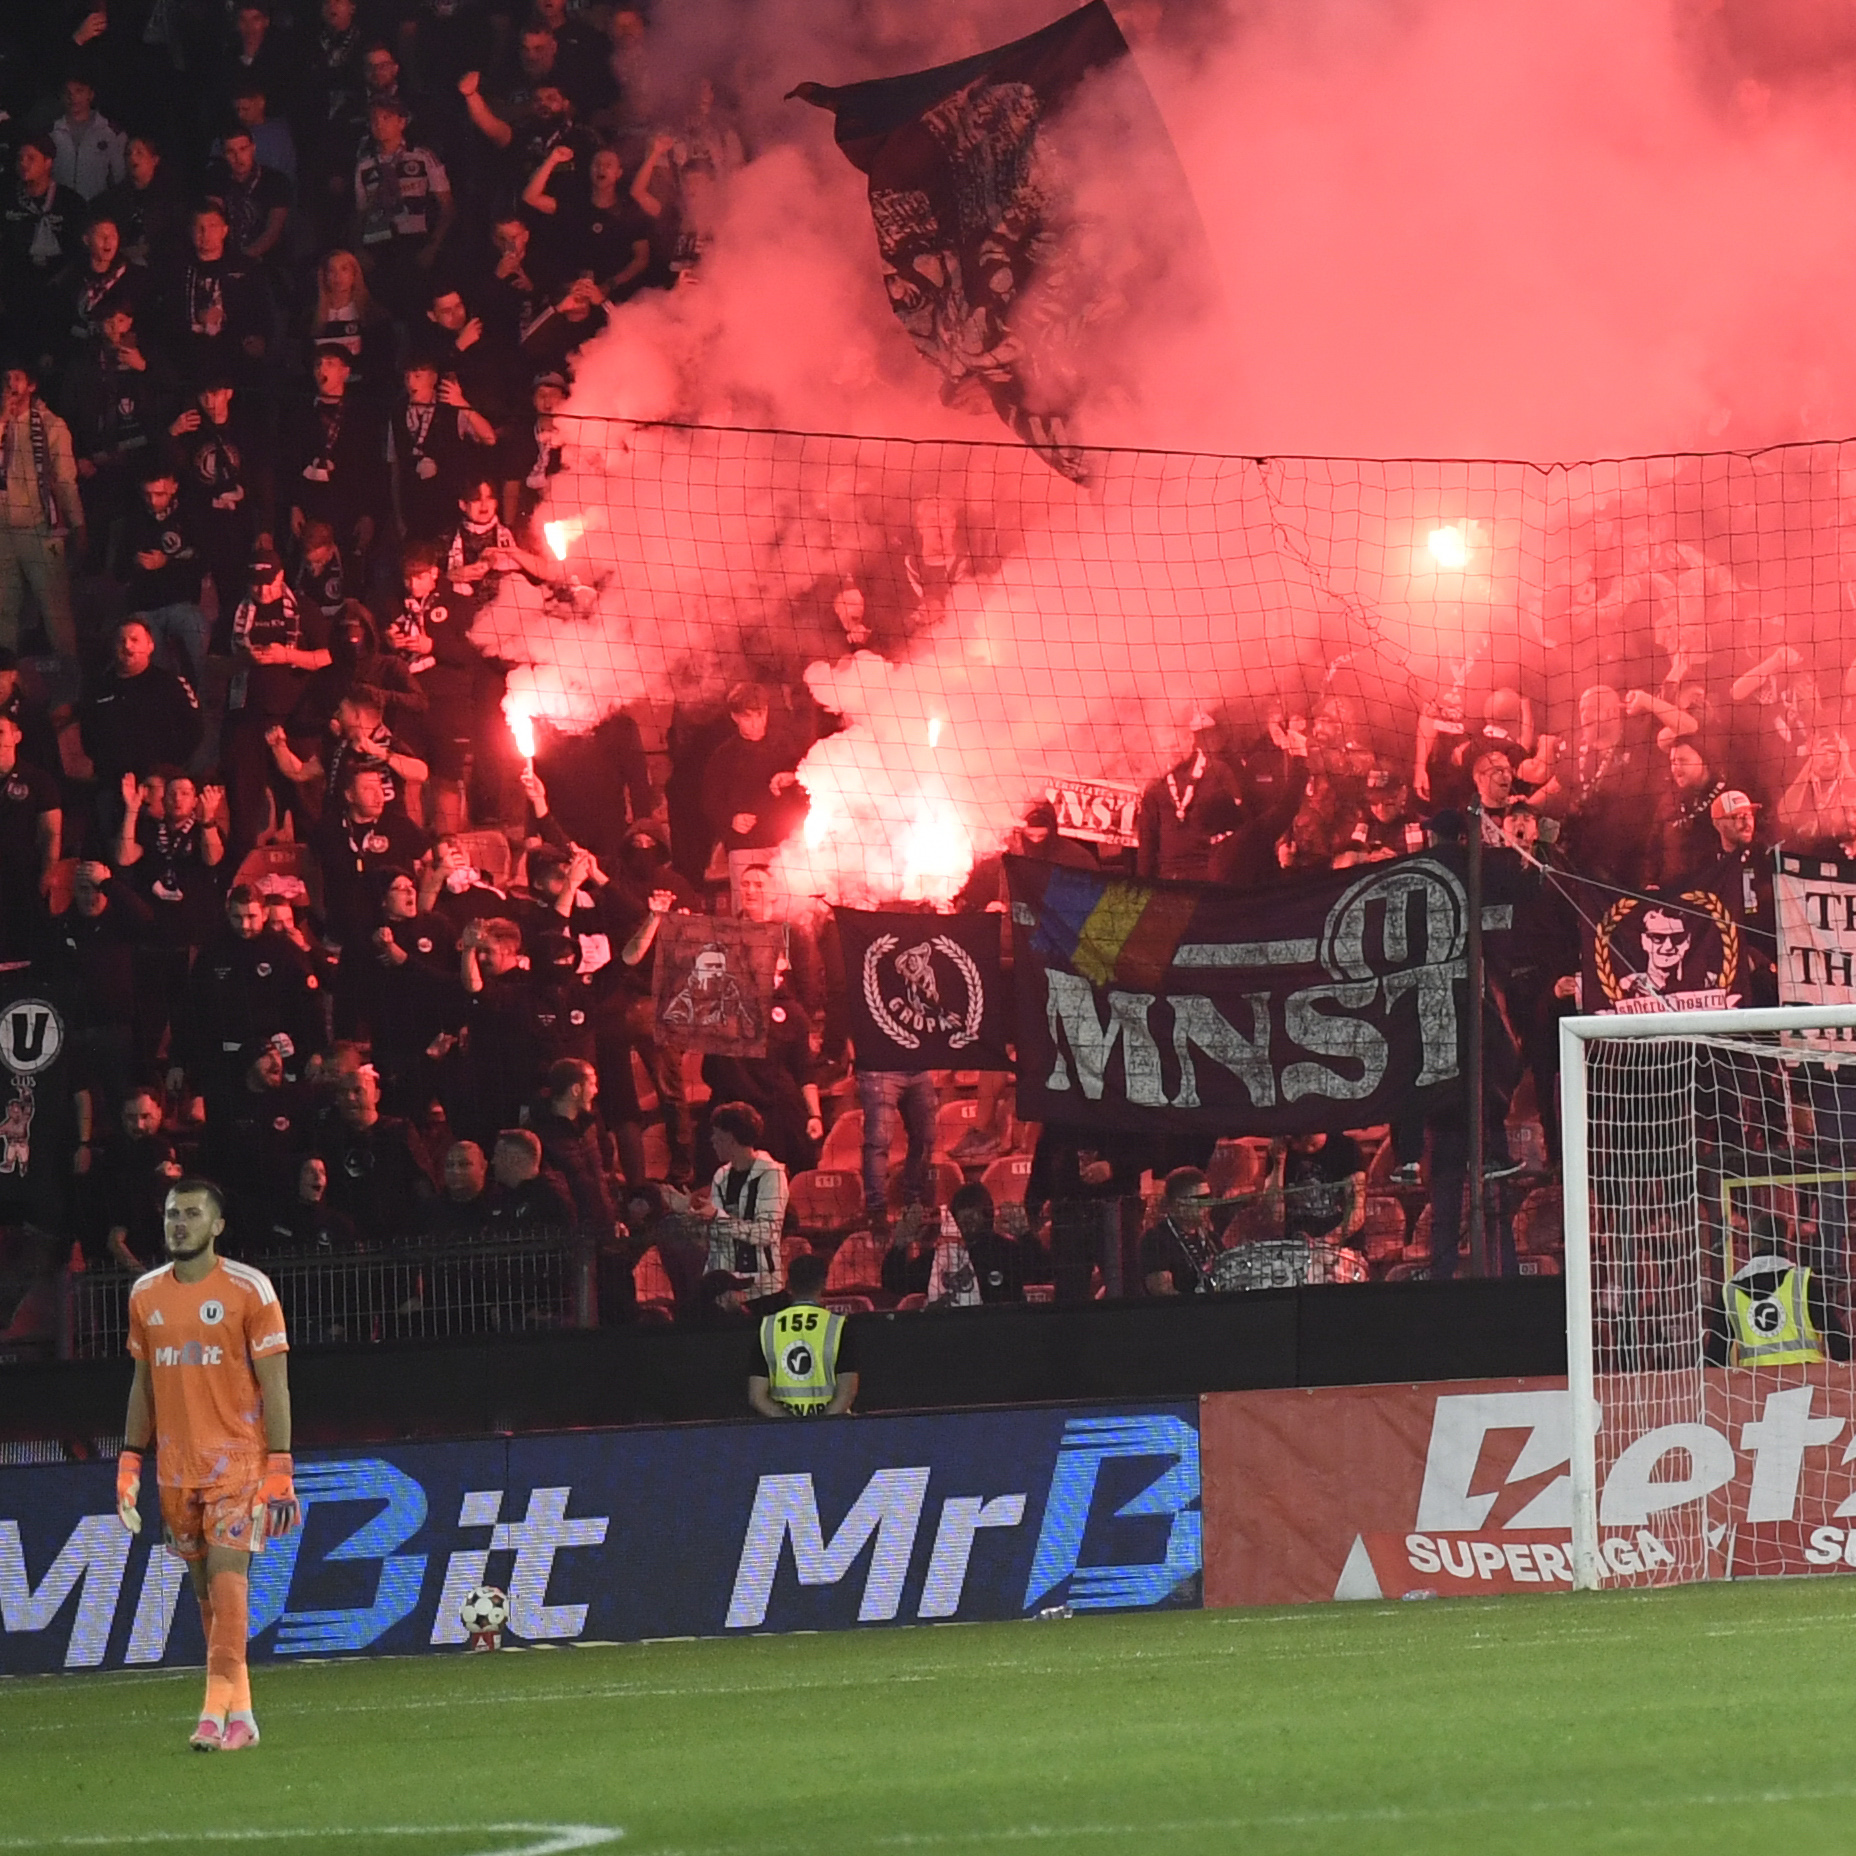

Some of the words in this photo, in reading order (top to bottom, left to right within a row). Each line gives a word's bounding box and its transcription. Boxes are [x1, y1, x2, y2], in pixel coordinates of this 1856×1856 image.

[11, 1012, 50, 1063] U
[1045, 958, 1470, 1108] MNST
[777, 1313, 819, 1333] 155
